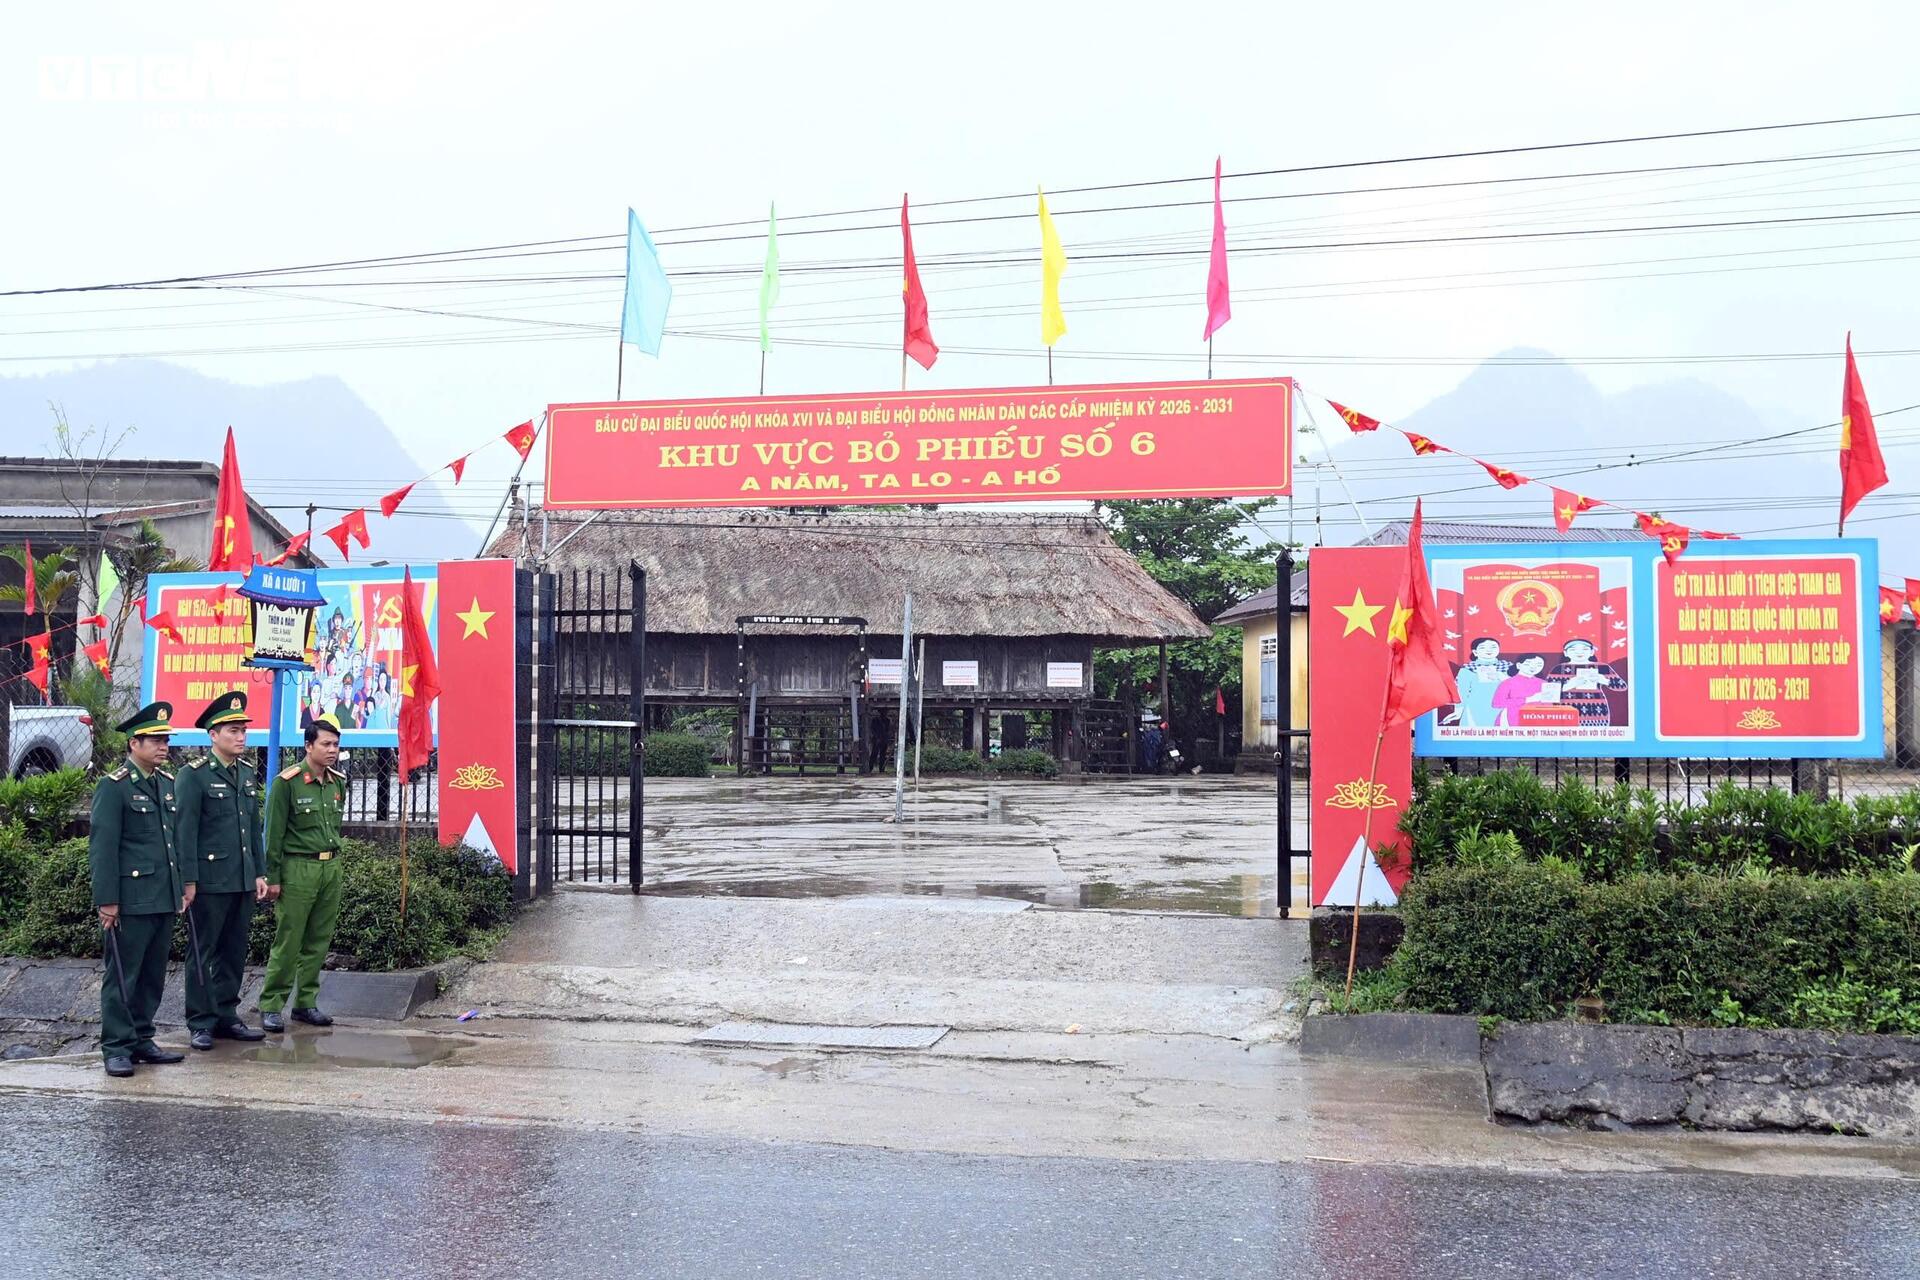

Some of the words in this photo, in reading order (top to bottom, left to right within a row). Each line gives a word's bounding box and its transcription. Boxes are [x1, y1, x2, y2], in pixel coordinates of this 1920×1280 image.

[596, 414, 618, 432] BẦU
[621, 413, 638, 432] CỬ
[640, 417, 660, 435] ĐẠI
[664, 410, 691, 431] BIỂU
[694, 410, 727, 430] QUỐC
[730, 411, 751, 432] HỘI
[755, 410, 789, 427] KHÓA
[792, 412, 812, 426] XVI
[816, 408, 833, 426] VÀ
[836, 411, 857, 429] ĐẠI
[861, 403, 890, 424] BIỂU
[894, 406, 915, 427] HỘI
[919, 402, 955, 422] ĐỒNG
[959, 403, 995, 421] NHÂN
[999, 402, 1026, 420] DÂN
[1029, 400, 1056, 419] CÁC
[1060, 398, 1086, 418] CẤP
[1090, 399, 1133, 420] NHIỆM
[1137, 397, 1156, 416] KỲ
[1160, 400, 1191, 415] 2026
[1203, 398, 1232, 413] 2031
[659, 444, 740, 467] KHU
[752, 438, 833, 470] VỰC
[848, 431, 900, 463] BỎ
[916, 425, 1045, 461] PHIẾU
[1060, 422, 1115, 457] SỐ
[1131, 432, 1155, 455] 6
[741, 477, 760, 490] A
[771, 473, 848, 491] NĂM,
[859, 474, 900, 488] TA
[912, 472, 952, 487] LO
[981, 471, 1002, 485] A
[1014, 464, 1060, 485] HỐ
[262, 572, 273, 588] XÃ
[275, 576, 280, 589] A
[302, 580, 306, 593] 1
[1674, 570, 1687, 597] CỬ
[1688, 575, 1703, 596] TRI
[1705, 572, 1717, 596] XÃ
[1718, 575, 1725, 596] A
[1748, 575, 1753, 595] 1
[1754, 572, 1776, 596] TÍCH
[1778, 571, 1796, 599] CỰC
[1798, 573, 1824, 595] THAM
[1826, 573, 1841, 595] GIA
[1679, 602, 1696, 631] BẦU
[1698, 604, 1712, 631] CỬ
[1713, 609, 1728, 633] ĐẠI
[1730, 602, 1750, 630] BIỂU
[1752, 602, 1777, 632] QUỐC
[1779, 605, 1795, 633] HỘI
[1797, 606, 1821, 630] KHÓA
[1823, 608, 1838, 629] XVI
[1668, 643, 1680, 665] VÀ
[1682, 644, 1697, 668] ĐẠI
[1699, 636, 1719, 665] BIỂU
[1721, 640, 1737, 668] HỘI
[1739, 637, 1763, 665] ĐỒNG
[1766, 640, 1789, 665] NHÂN
[1792, 640, 1809, 664] DÂN
[1812, 640, 1830, 664] CÁC
[1832, 636, 1850, 664] CẤP
[1710, 675, 1737, 703] NHIỆM
[1739, 675, 1751, 700] KỲ
[1753, 678, 1776, 700] 2026
[1785, 678, 1809, 700] 2031!
